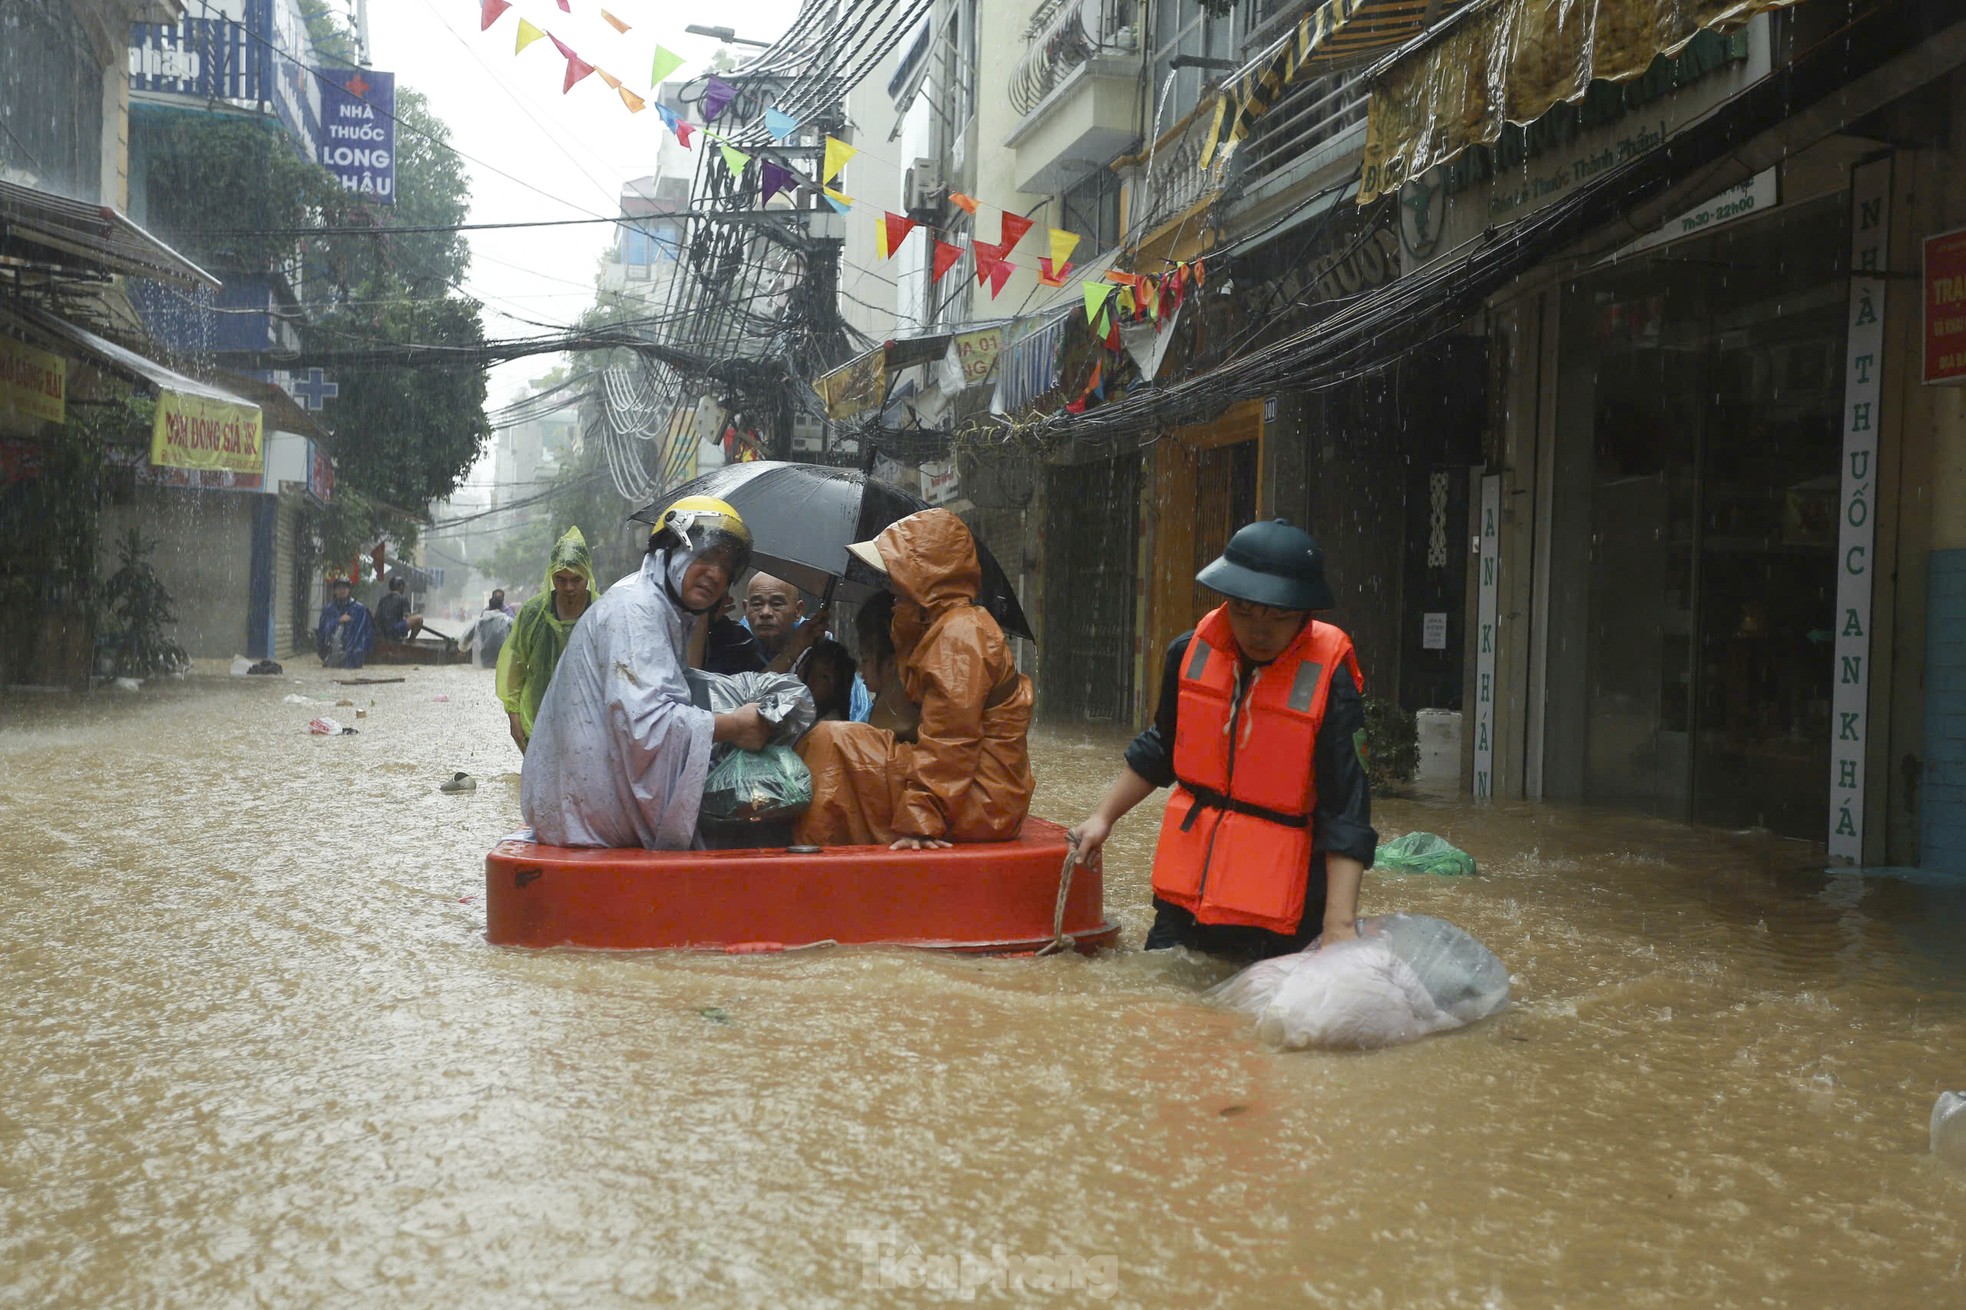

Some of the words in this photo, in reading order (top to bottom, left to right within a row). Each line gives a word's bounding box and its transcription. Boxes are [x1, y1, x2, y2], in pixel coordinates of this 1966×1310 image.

[340, 103, 374, 119] NHÀ
[329, 123, 385, 141] THUỐC
[323, 146, 390, 169] LONG
[336, 172, 391, 196] HÂU
[1855, 198, 1881, 325] NHÀ
[1265, 401, 1275, 420] 101
[223, 415, 241, 454] GIÁ
[1846, 354, 1874, 576] THUỐC
[1484, 507, 1495, 586] AN
[1841, 608, 1863, 684] AN
[1834, 712, 1859, 866] KHÁ
